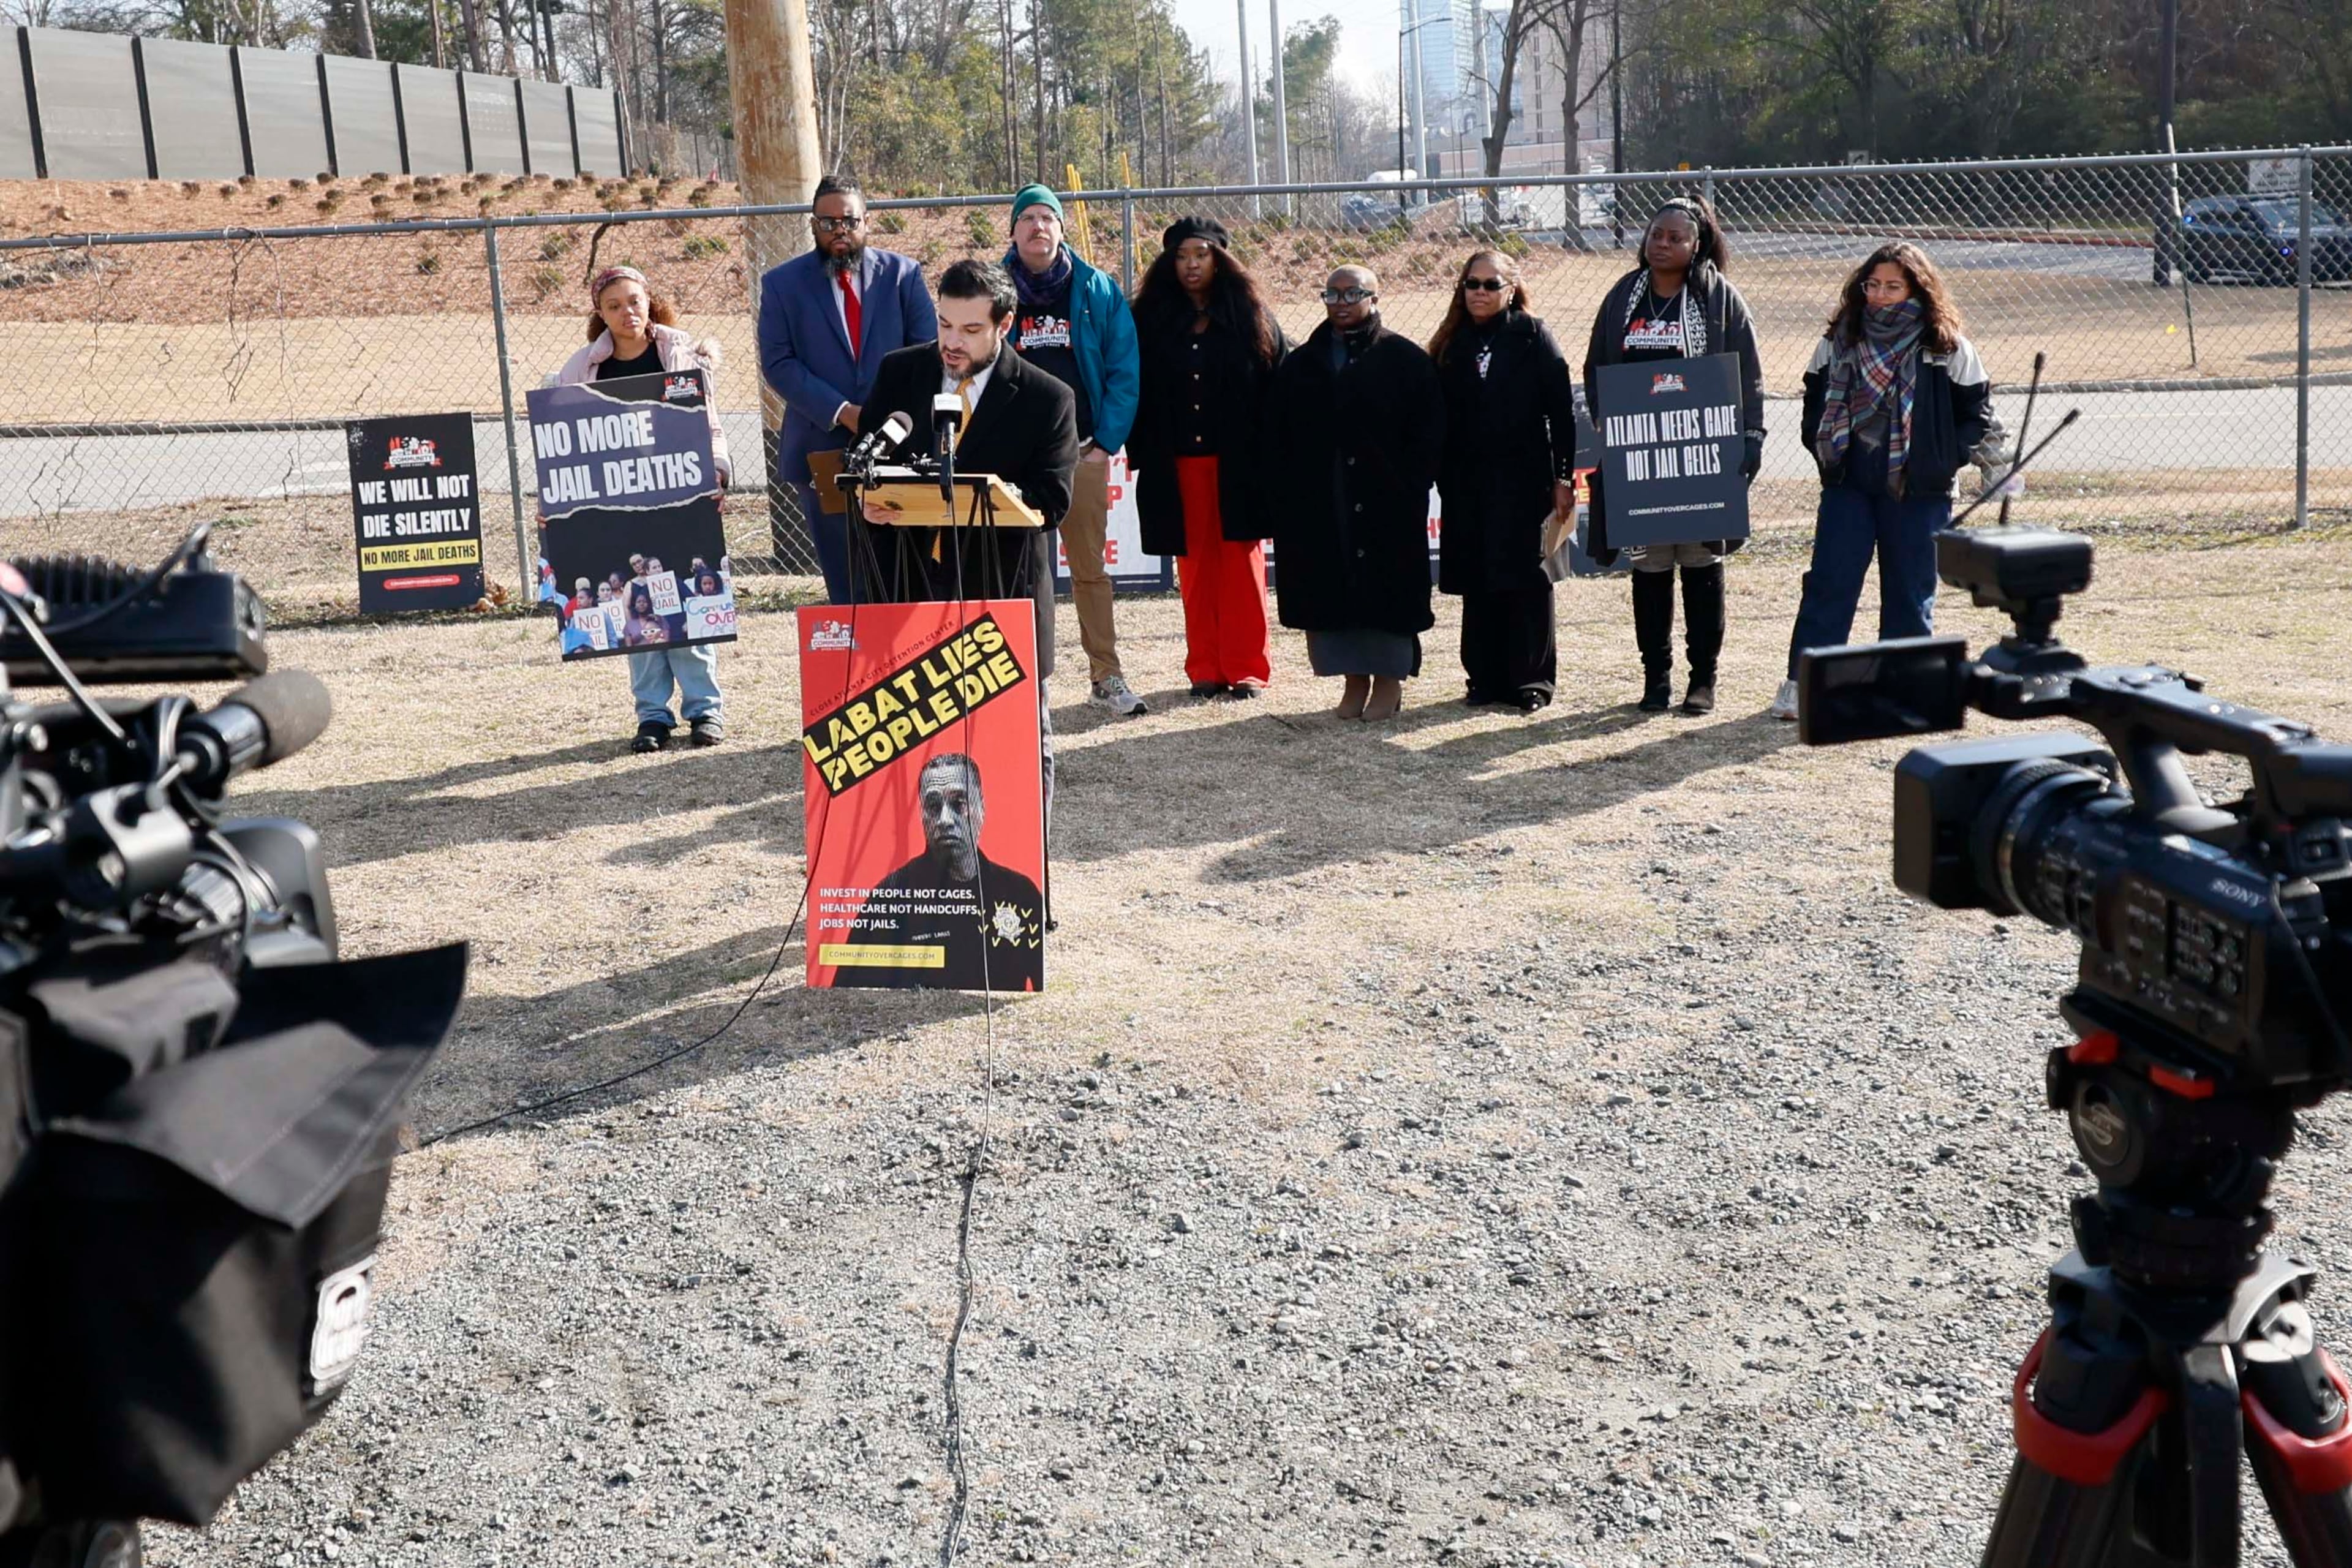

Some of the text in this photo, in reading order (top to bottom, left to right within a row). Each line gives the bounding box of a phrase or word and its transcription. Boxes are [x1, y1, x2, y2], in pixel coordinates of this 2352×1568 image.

[533, 410, 655, 459] NO MORE
[1606, 404, 1738, 447] ATLANTA NEEDS CARE
[1626, 443, 1721, 481] NOT JAIL CELLS
[358, 474, 470, 505] WE WILL NOT
[542, 450, 703, 504] JAIL DEATHS
[363, 507, 471, 538] DIE SILENTLY
[1628, 502, 1725, 516] COMMUNITYOVERCAGES.COM
[364, 545, 476, 565] NO MORE JAIL DEATHS
[652, 578, 673, 593] NO
[655, 598, 679, 609] JAIL
[578, 614, 600, 629] NO
[810, 698, 833, 716] CLOSE
[866, 668, 883, 679] CITY
[884, 641, 924, 668] DETENTION
[925, 620, 954, 642] CENTER
[802, 621, 1004, 764] LABAT LIES
[822, 651, 1020, 791] PEOPLE DIE
[820, 888, 975, 899] INVEST IN PEOPLE NOT CAGES.
[2211, 878, 2266, 907] SONY
[820, 904, 887, 913] HEALTHCARE
[889, 904, 911, 913] NOT
[819, 919, 899, 930] JOBS NOT JAILS.
[829, 951, 935, 960] COMMUNITYOVERCAGES.COM
